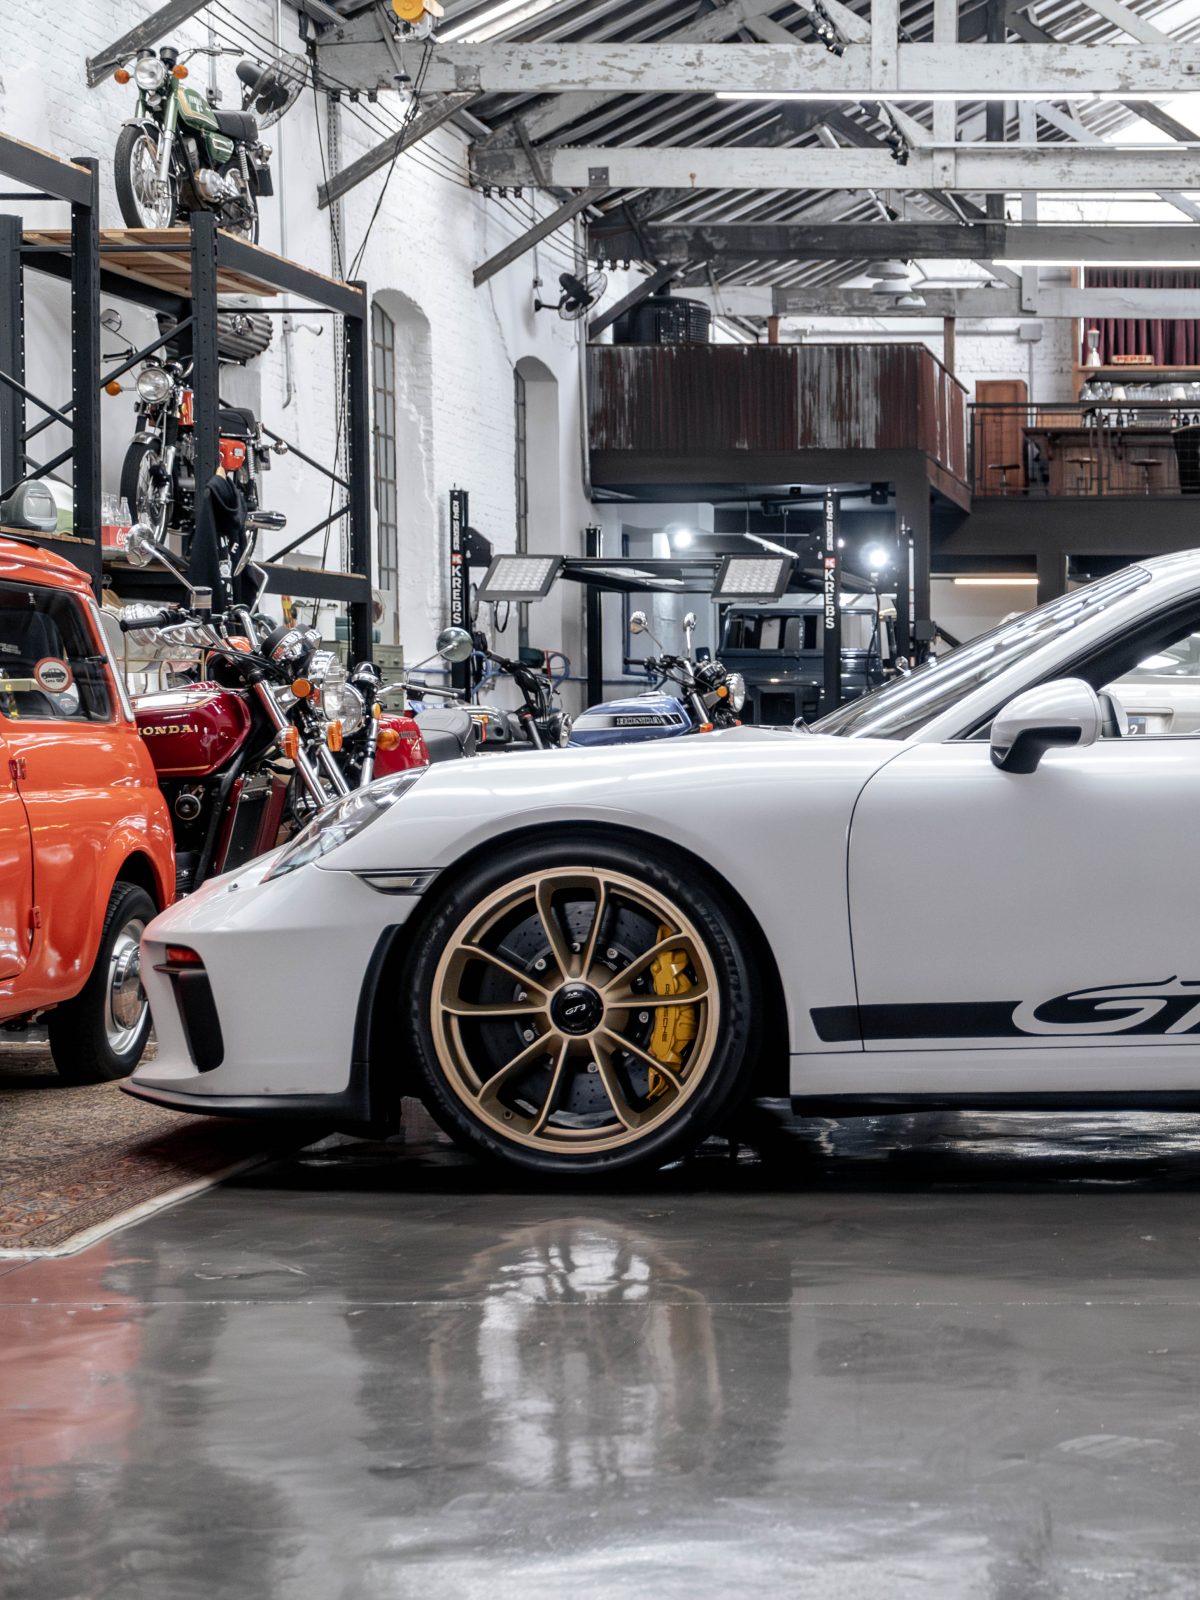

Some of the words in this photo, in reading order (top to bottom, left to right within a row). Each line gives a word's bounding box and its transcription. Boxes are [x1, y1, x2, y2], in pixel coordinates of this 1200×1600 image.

[451, 565, 462, 624] KREBS
[824, 569, 835, 629] KREBS
[616, 715, 662, 726] HONDA
[565, 1003, 587, 1016] GT3
